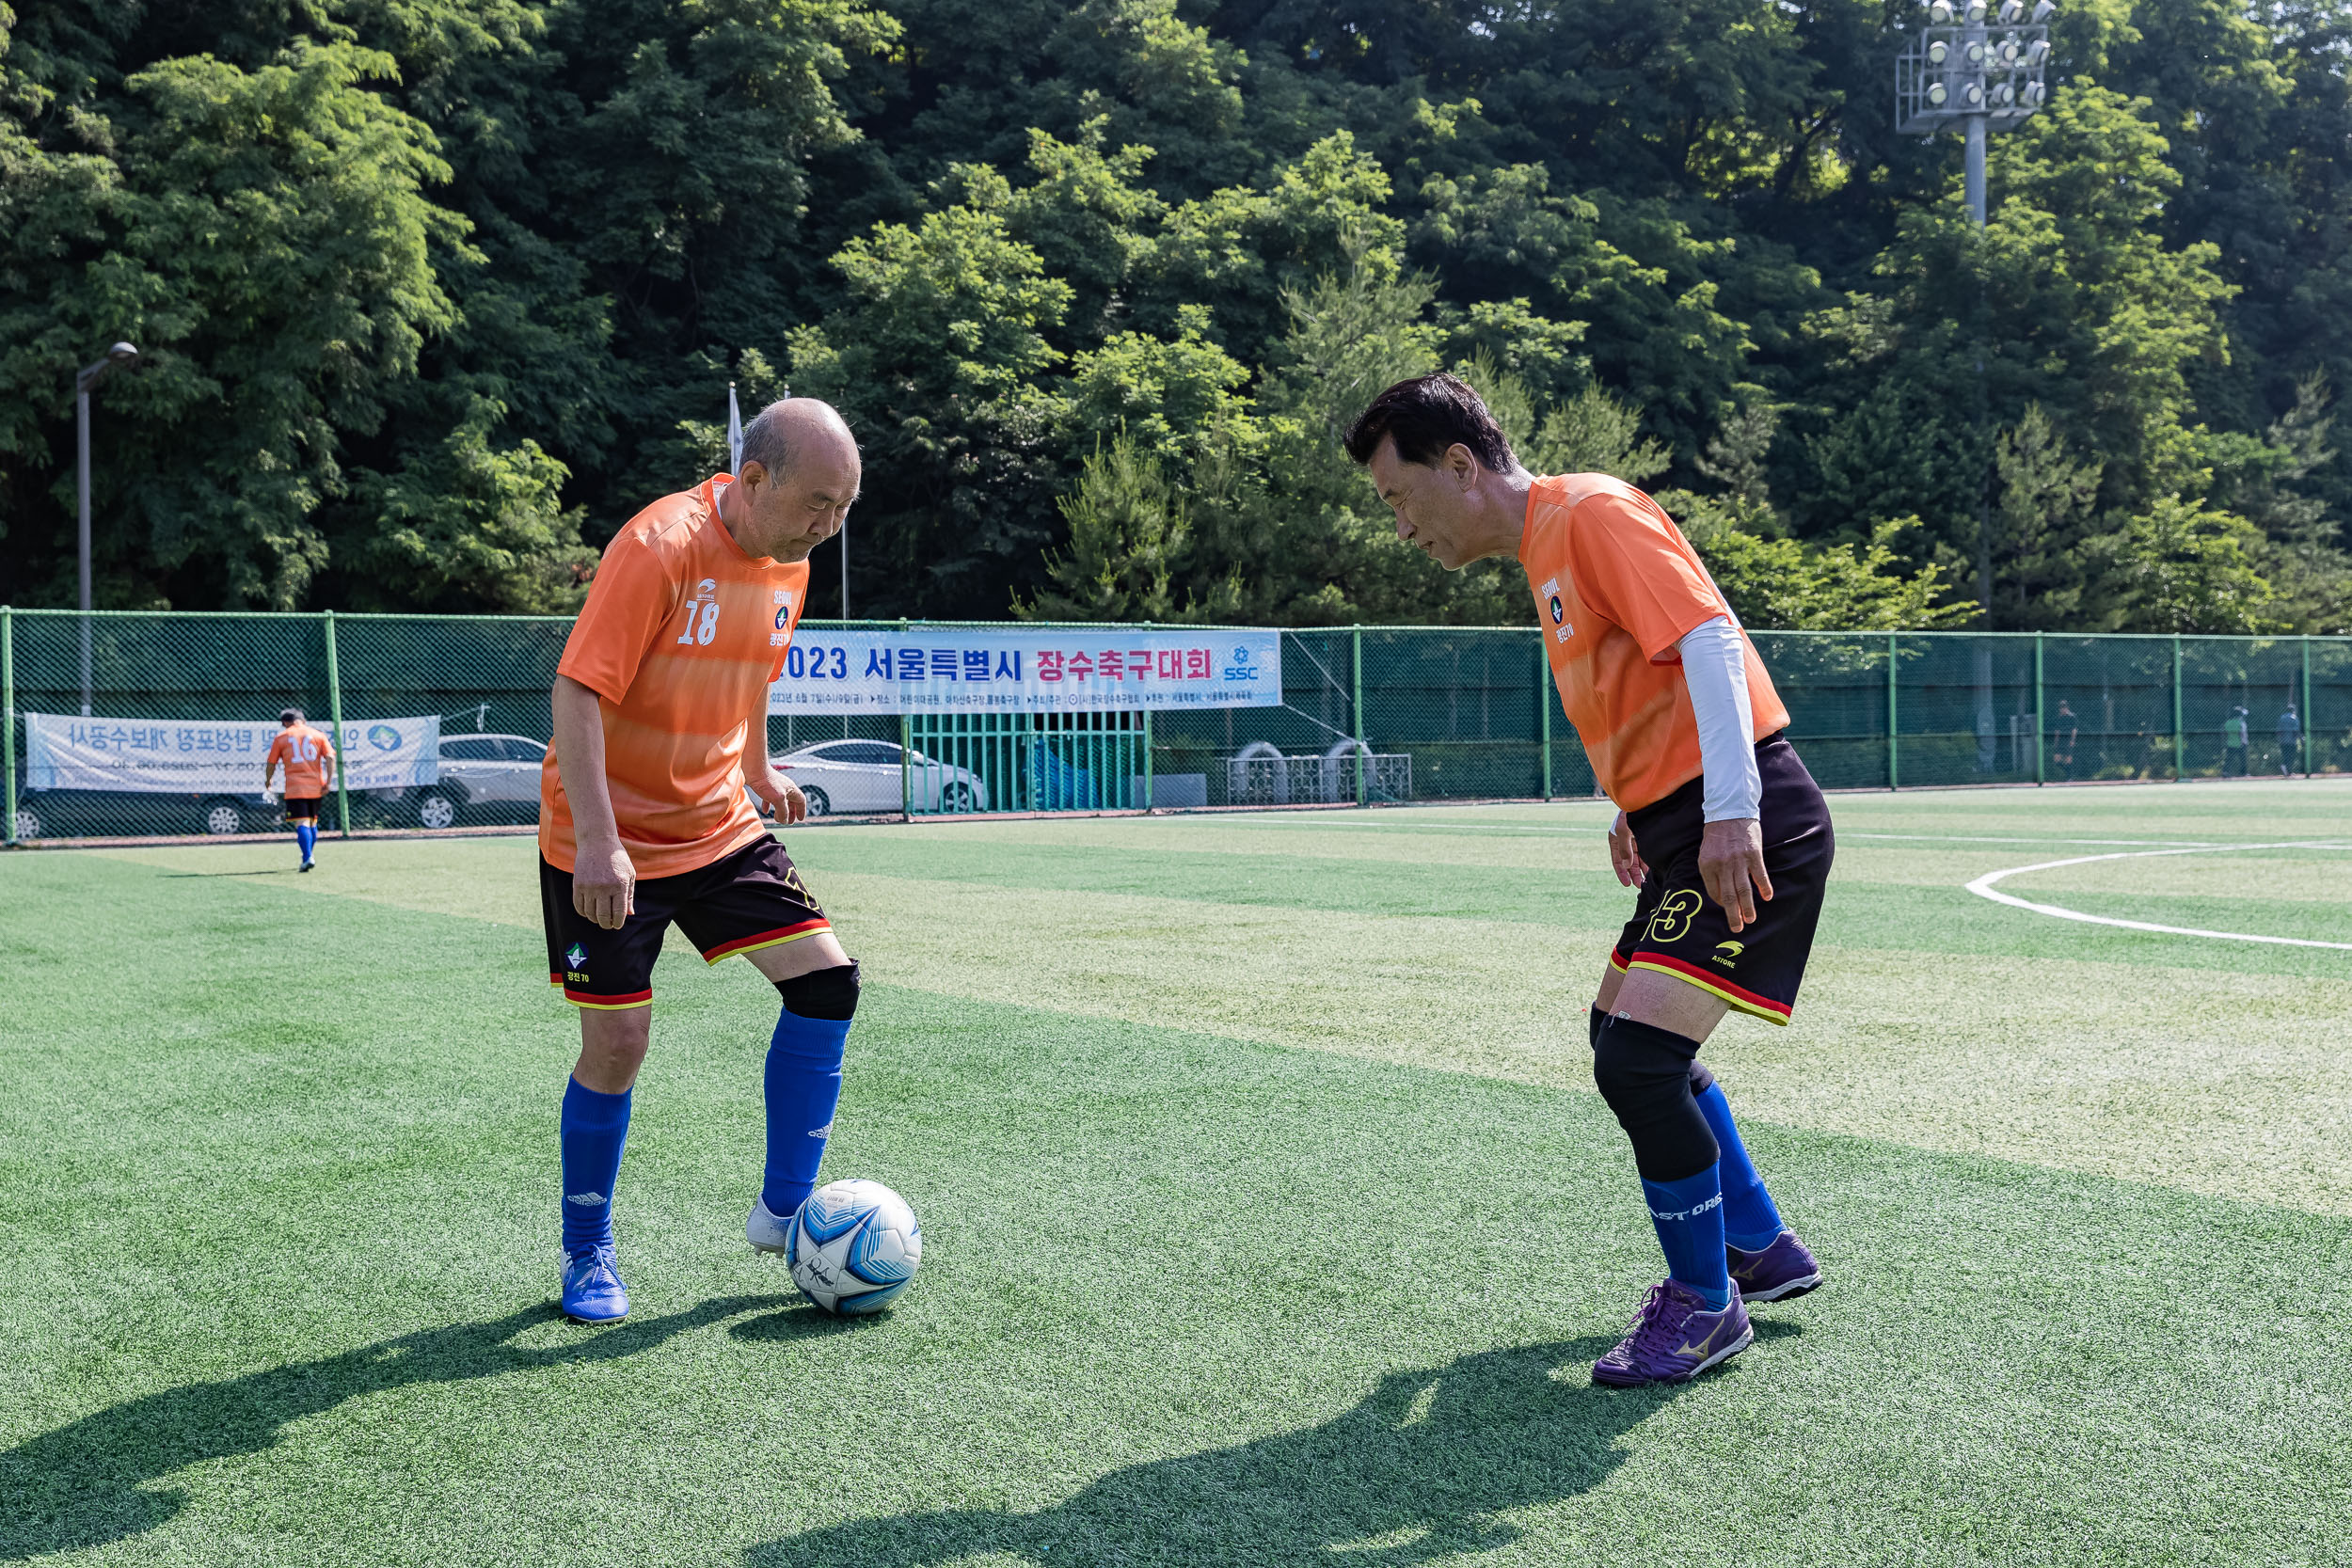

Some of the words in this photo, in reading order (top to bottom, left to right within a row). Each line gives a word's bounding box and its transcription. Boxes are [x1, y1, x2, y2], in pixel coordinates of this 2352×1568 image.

[773, 590, 792, 605] SEOUL
[1541, 578, 1561, 600] SEOUL
[676, 600, 720, 646] 18
[779, 646, 848, 679] 023
[865, 647, 1023, 682] 서울특별시
[1037, 648, 1212, 682] 장수축구대회
[1224, 666, 1259, 681] SSC
[288, 735, 318, 763] 16
[1711, 955, 1736, 969] ASTORE
[566, 1195, 608, 1207] adidas
